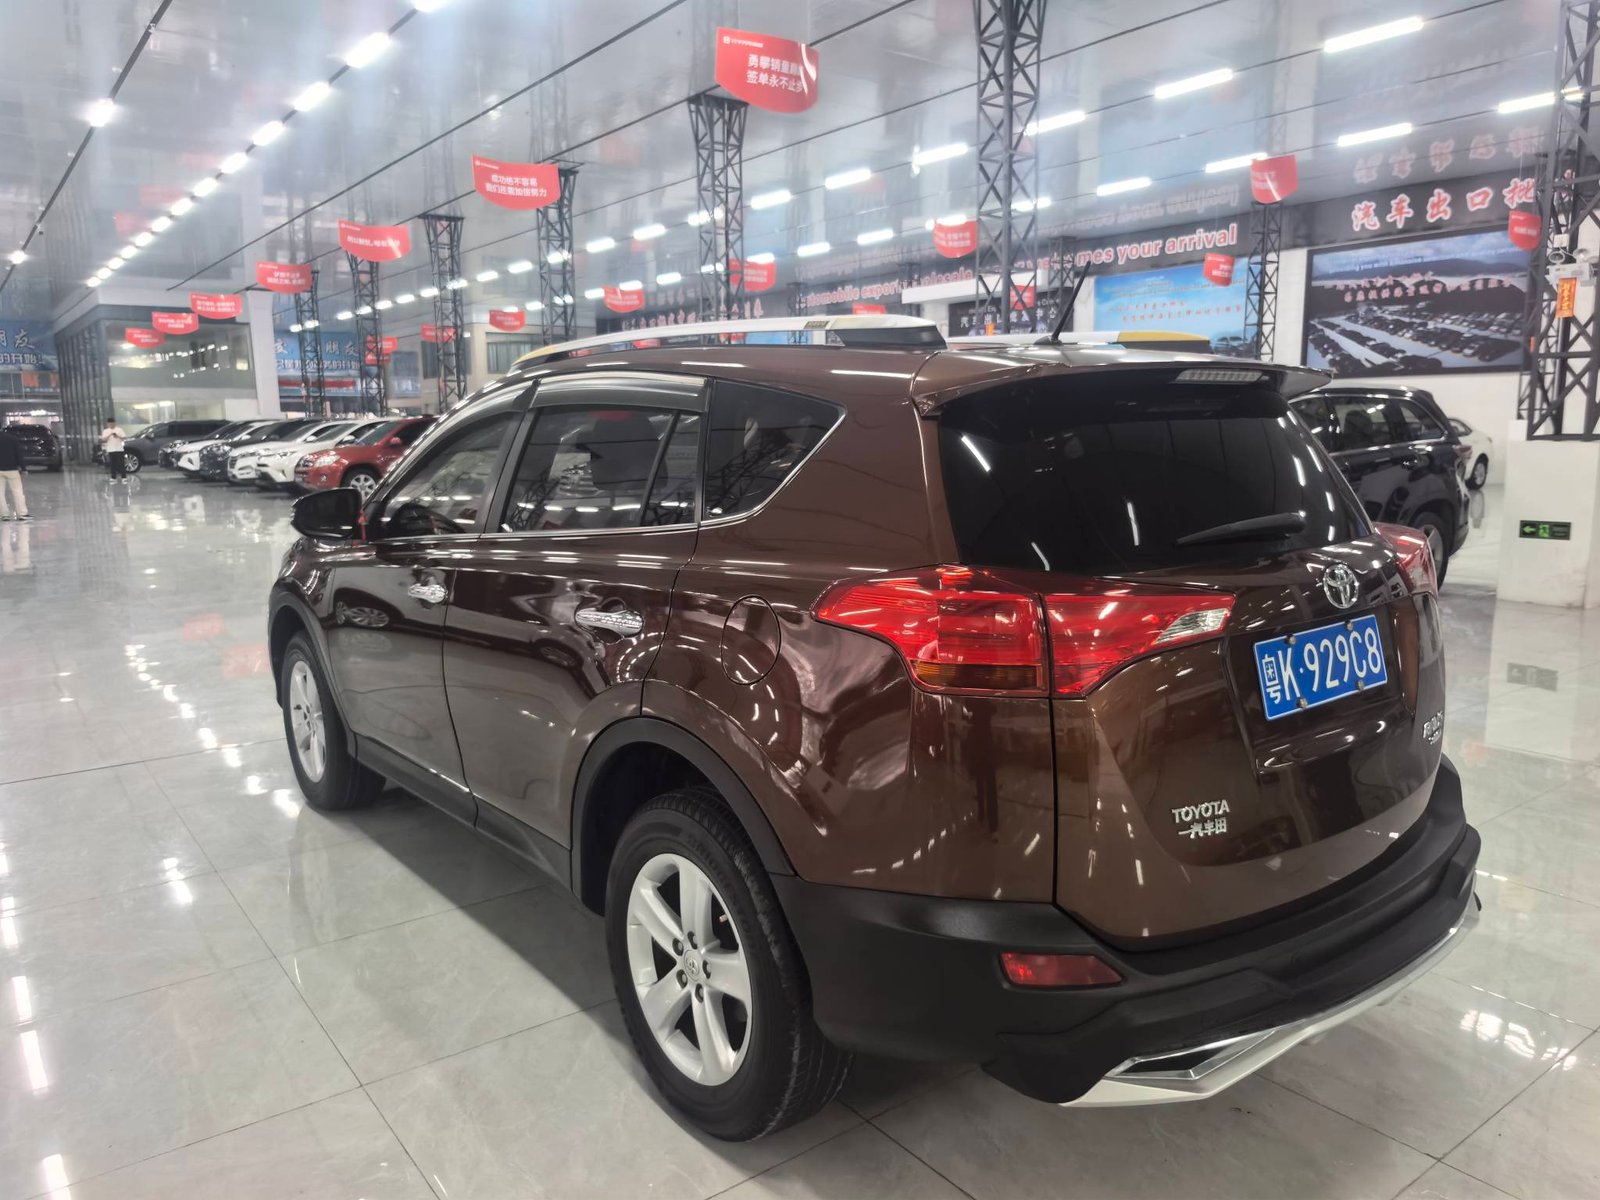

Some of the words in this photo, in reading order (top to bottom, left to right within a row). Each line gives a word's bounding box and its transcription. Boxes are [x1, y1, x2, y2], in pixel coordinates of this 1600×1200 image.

[1117, 240, 1162, 265] your
[1165, 223, 1237, 254] arrival
[1172, 800, 1229, 823] TOYOTA
[1178, 818, 1227, 839] 一汽丰田
